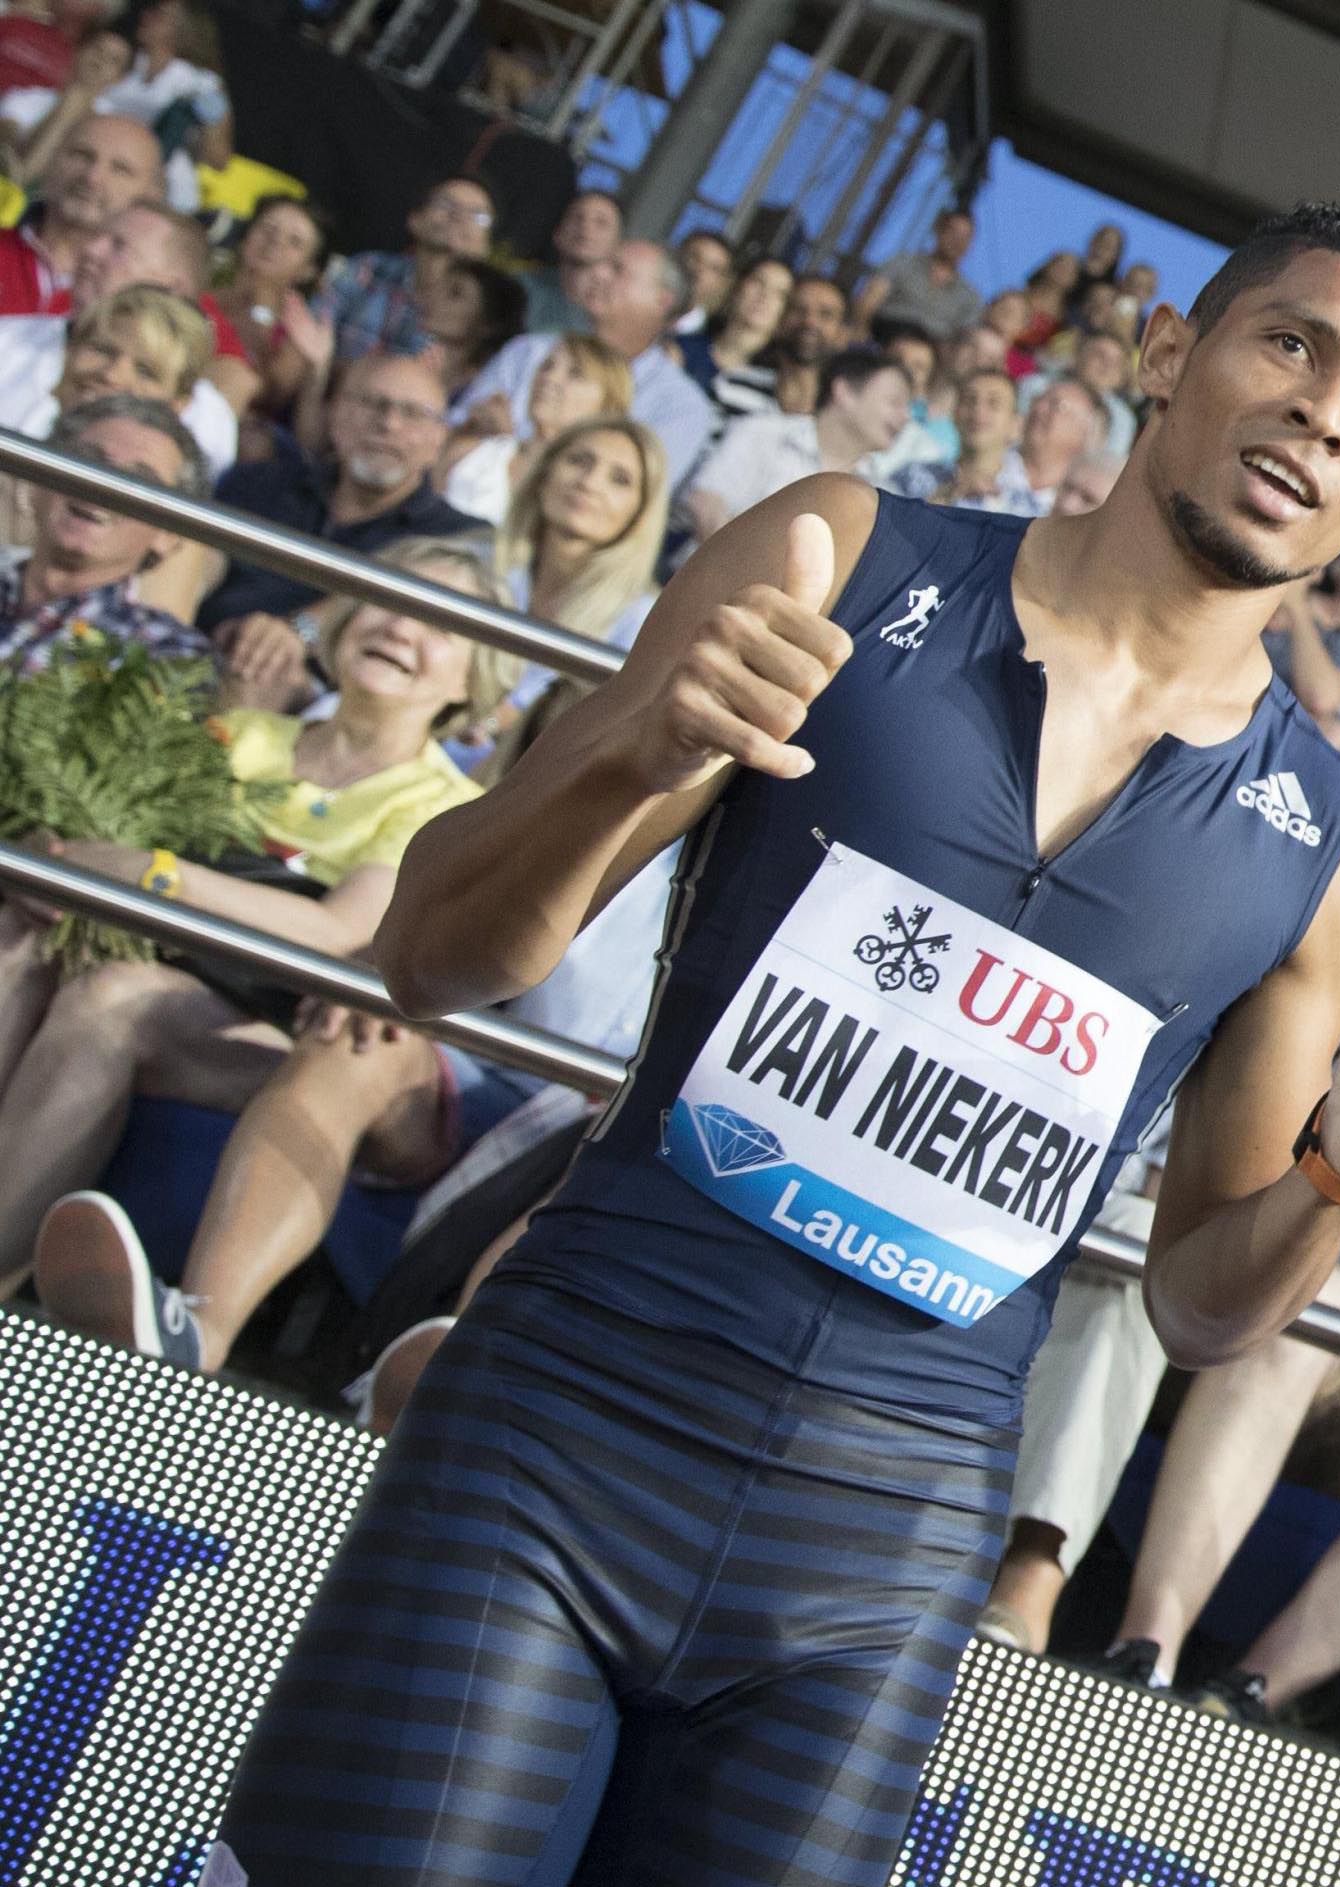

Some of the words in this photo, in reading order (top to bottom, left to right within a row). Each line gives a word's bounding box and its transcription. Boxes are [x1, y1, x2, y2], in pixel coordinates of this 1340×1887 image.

[724, 972, 879, 1121] VAN
[852, 1045, 1099, 1236] NIEKERK
[957, 948, 1109, 1077] UBS
